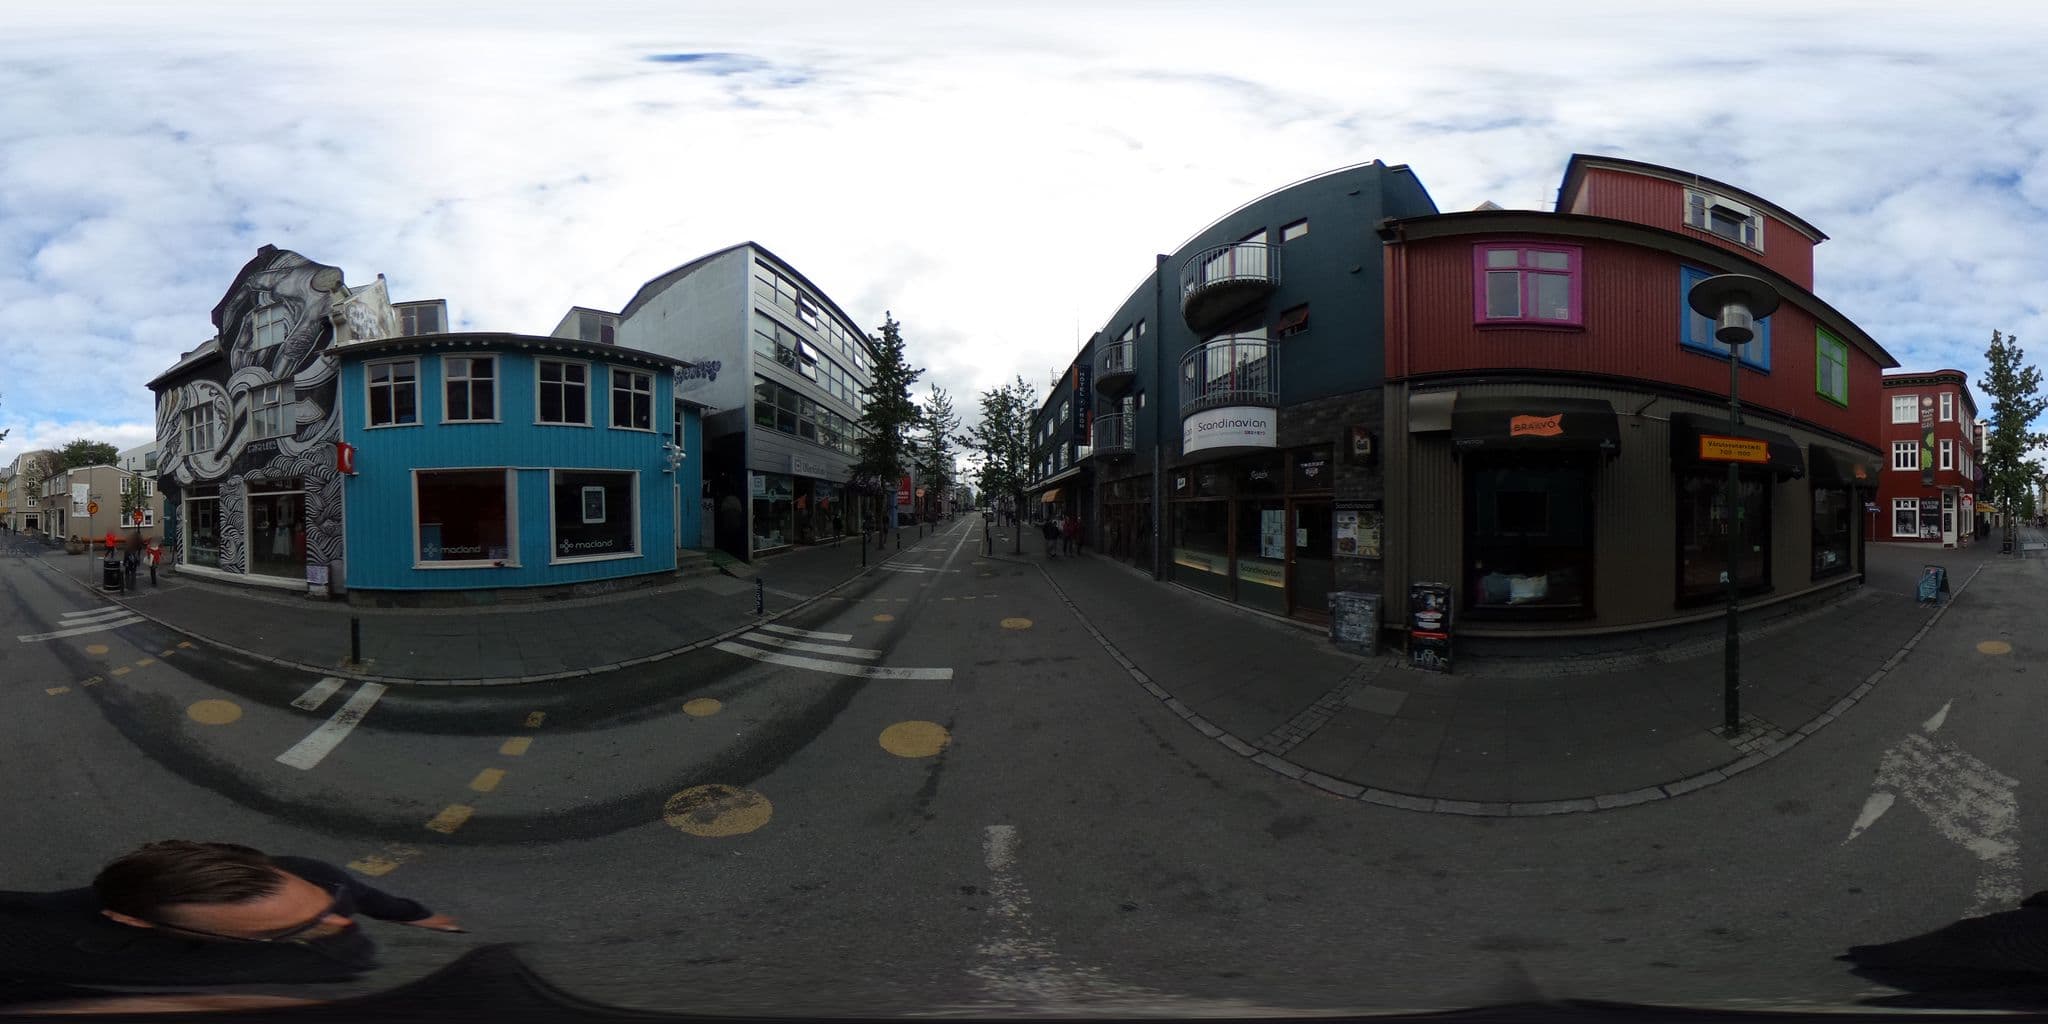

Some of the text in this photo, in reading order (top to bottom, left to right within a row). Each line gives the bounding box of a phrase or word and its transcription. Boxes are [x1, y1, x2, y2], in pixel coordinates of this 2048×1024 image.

[1198, 418, 1267, 432] Scandinavian
[441, 544, 481, 554] macland
[575, 538, 614, 549] macland
